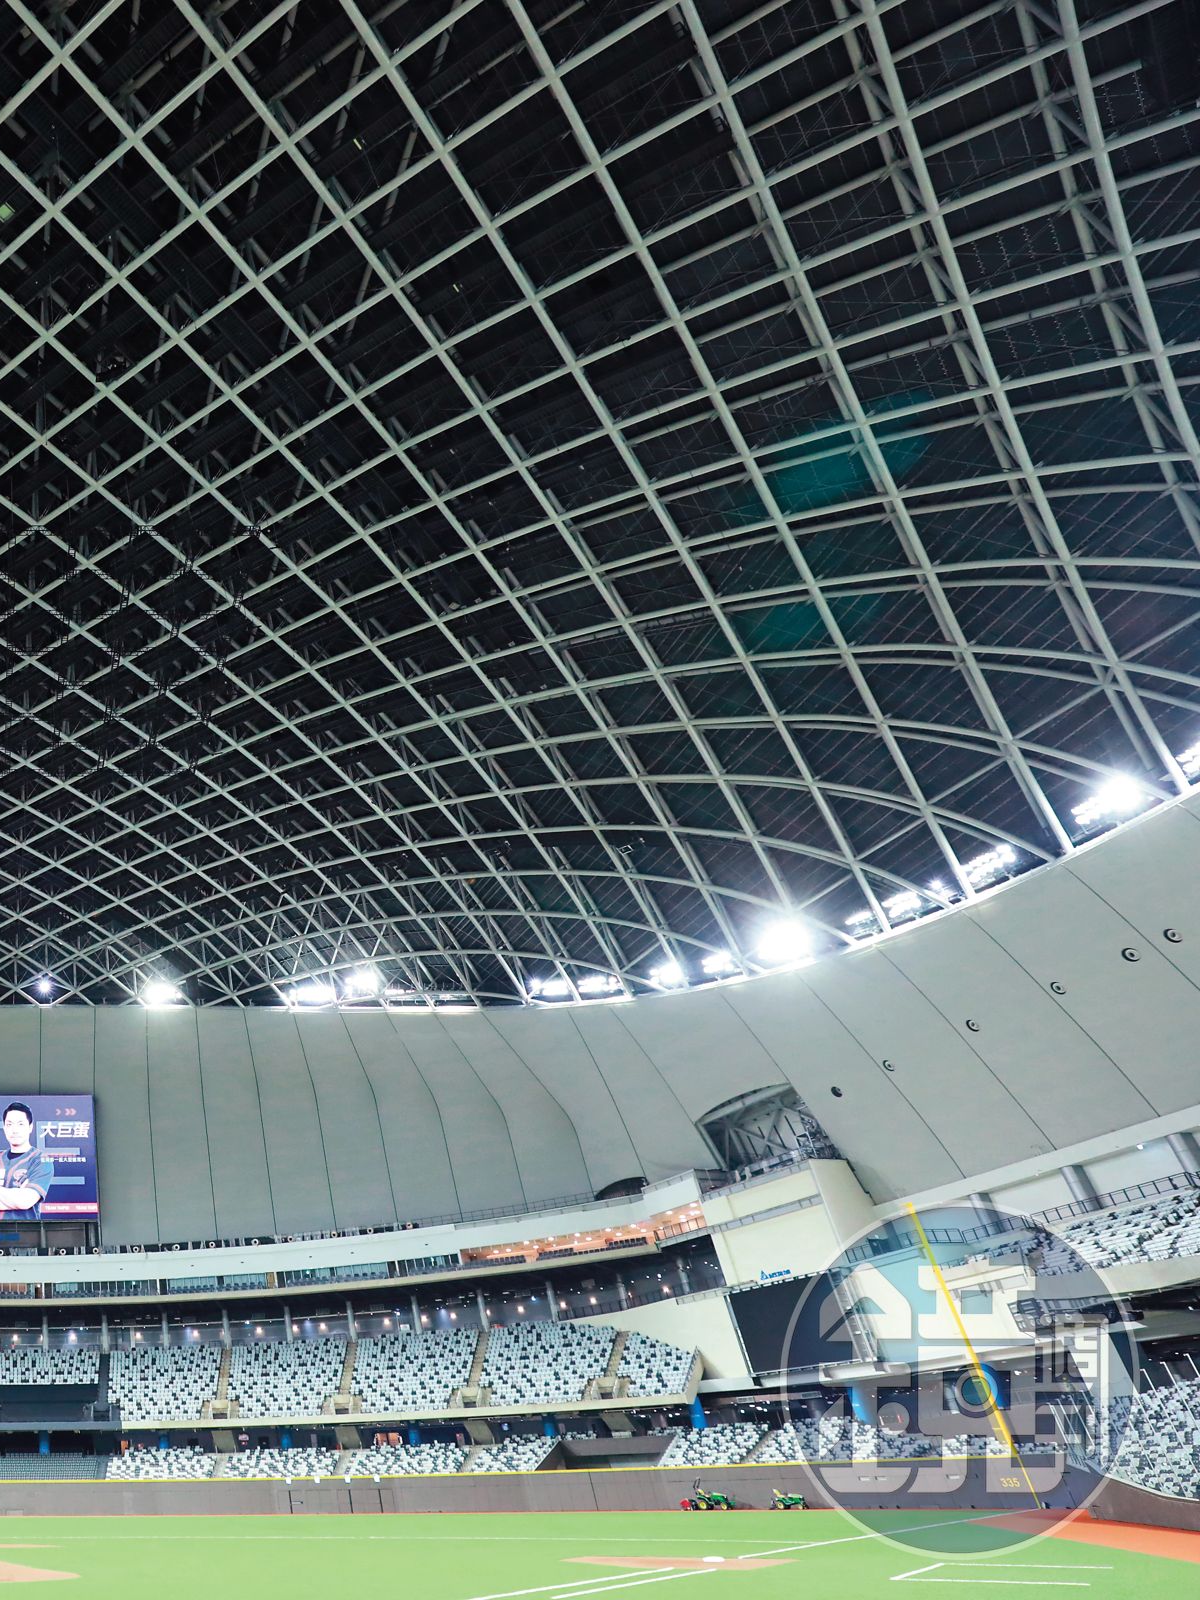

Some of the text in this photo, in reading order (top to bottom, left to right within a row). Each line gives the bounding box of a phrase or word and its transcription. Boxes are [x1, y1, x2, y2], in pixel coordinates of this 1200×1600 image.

[40, 1121, 90, 1138] 大巨蛋
[999, 1477, 1021, 1488] 335
